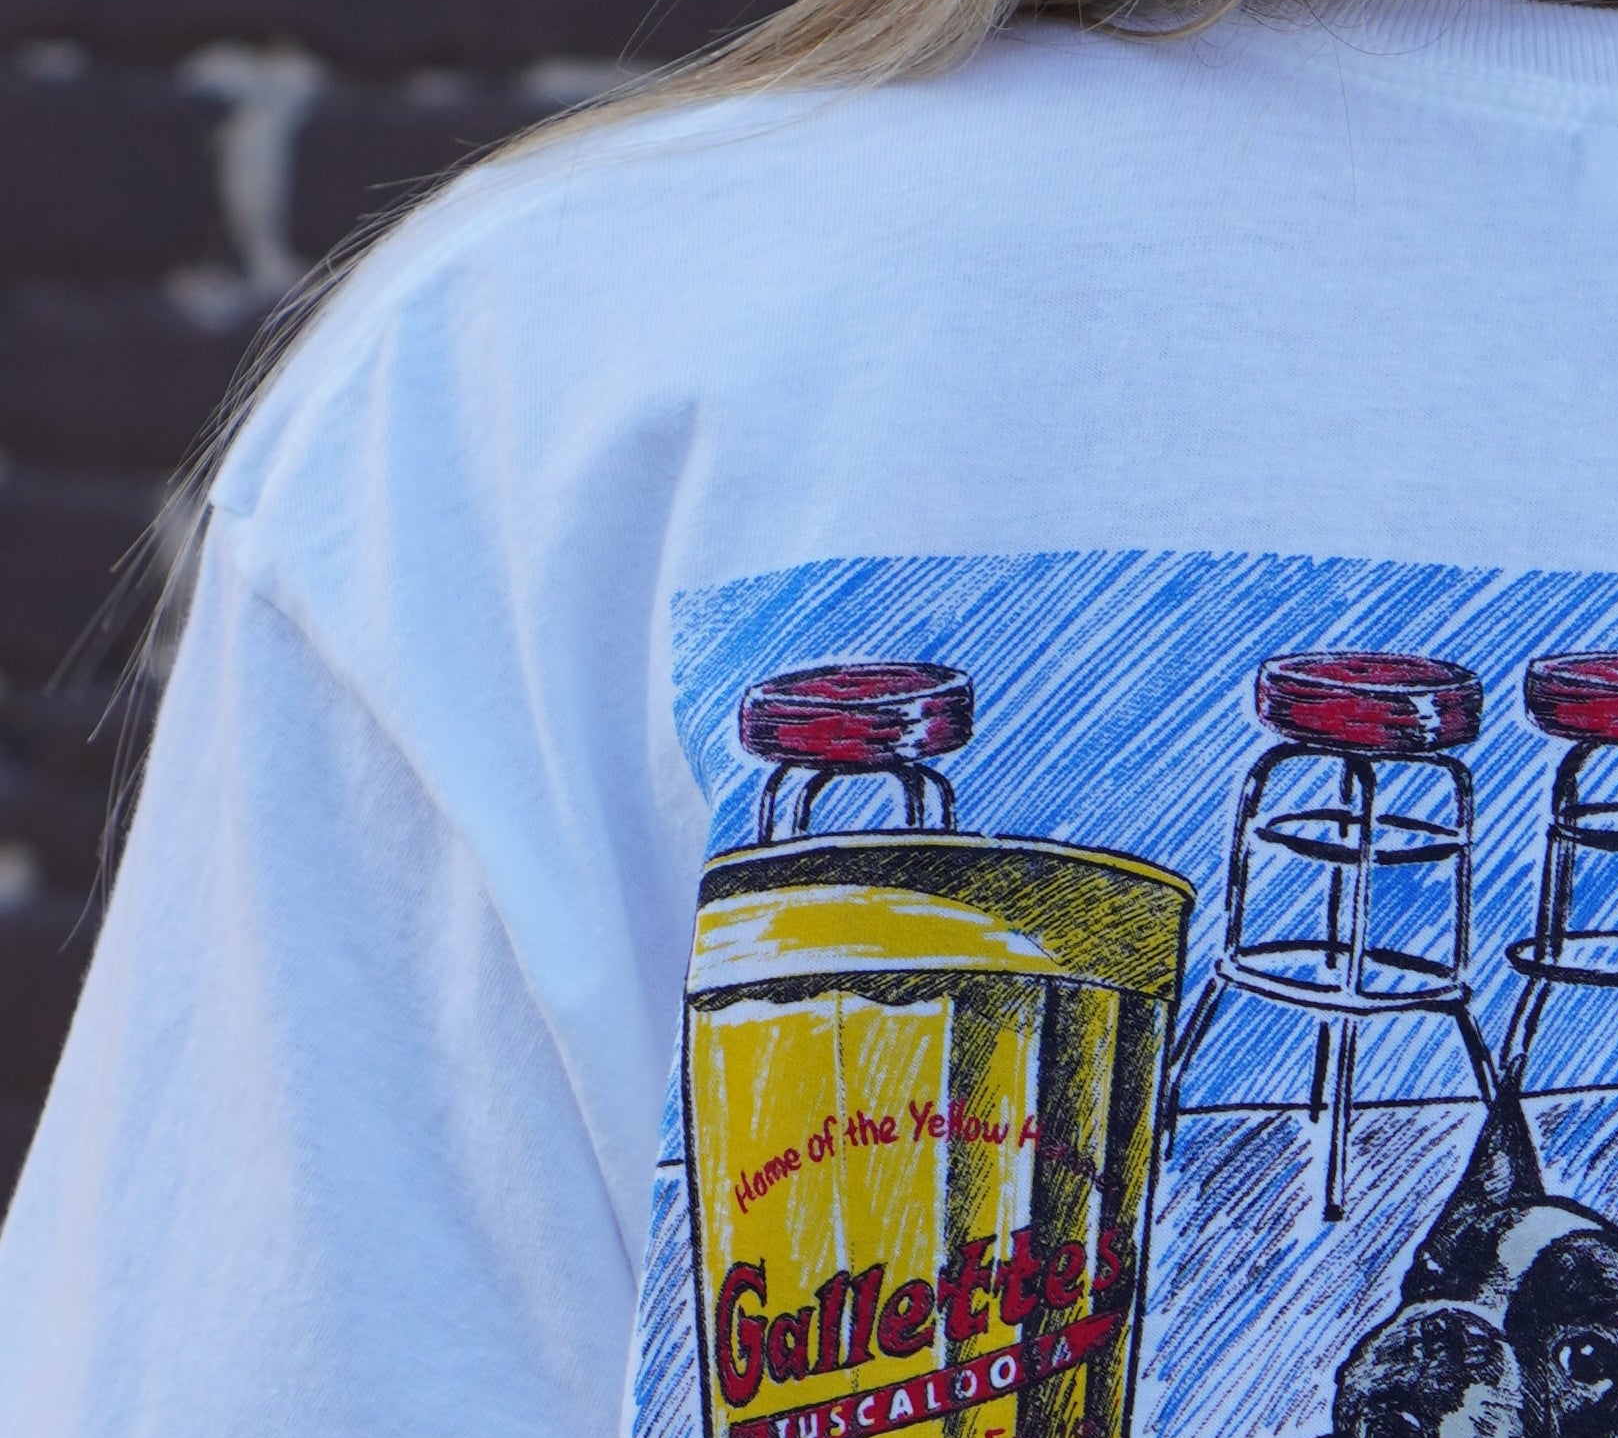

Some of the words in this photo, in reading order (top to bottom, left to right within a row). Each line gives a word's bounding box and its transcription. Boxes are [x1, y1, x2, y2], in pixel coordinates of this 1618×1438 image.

[734, 1147, 802, 1215] Home
[807, 1114, 838, 1164] of
[843, 1109, 900, 1147] the
[908, 1098, 1010, 1145] Yellow
[714, 1224, 1122, 1408] Gallettes
